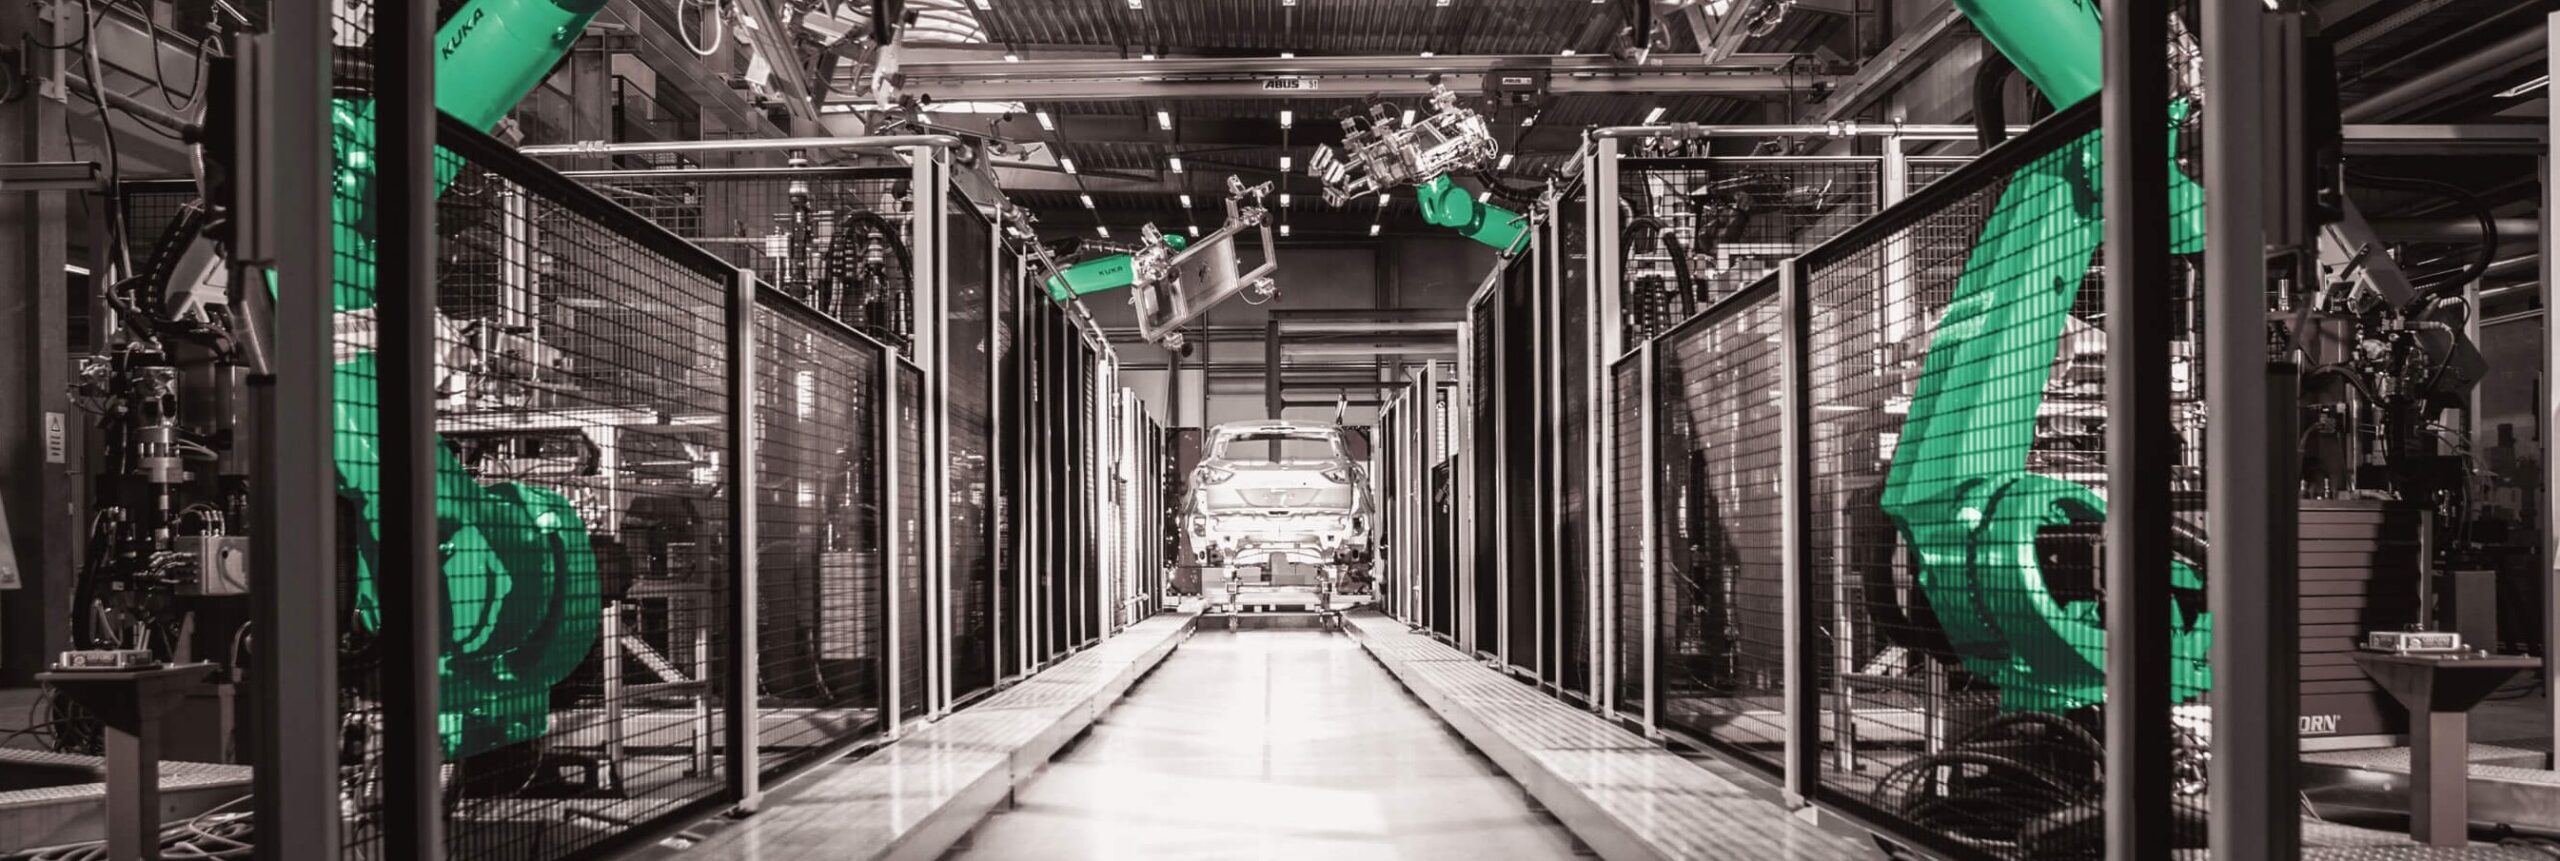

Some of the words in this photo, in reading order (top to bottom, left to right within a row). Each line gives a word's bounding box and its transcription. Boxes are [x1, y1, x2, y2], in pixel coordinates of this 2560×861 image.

[441, 7, 484, 60] KUKA
[1265, 79, 1299, 88] ABUS
[1099, 265, 1123, 276] KUKA
[2299, 714, 2336, 733] ORN
